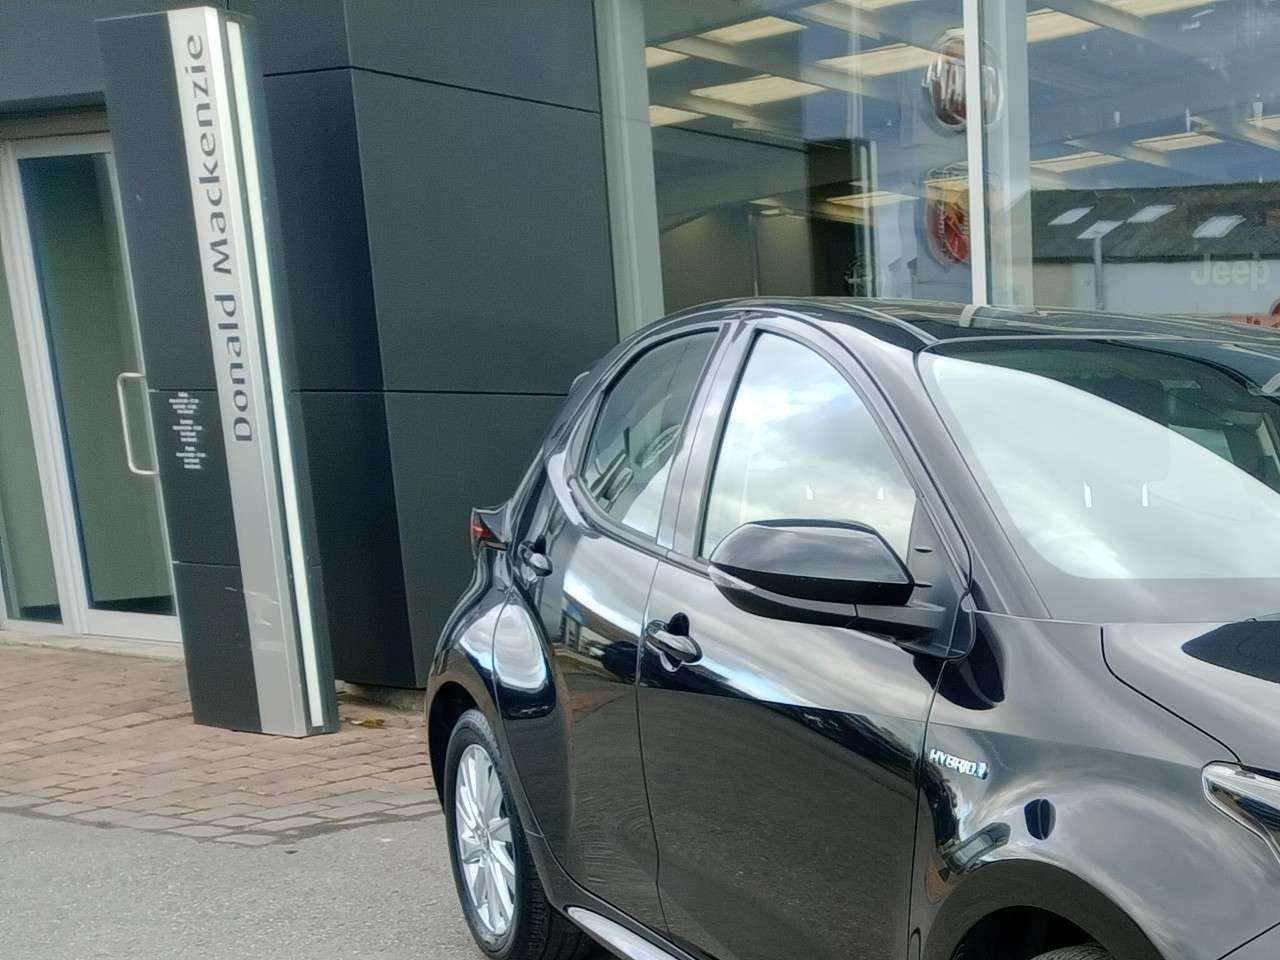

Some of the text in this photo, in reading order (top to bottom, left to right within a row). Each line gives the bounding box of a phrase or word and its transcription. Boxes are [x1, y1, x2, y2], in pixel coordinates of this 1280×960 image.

[184, 34, 252, 442] Donald Mackenzie
[1190, 252, 1271, 291] Jeep
